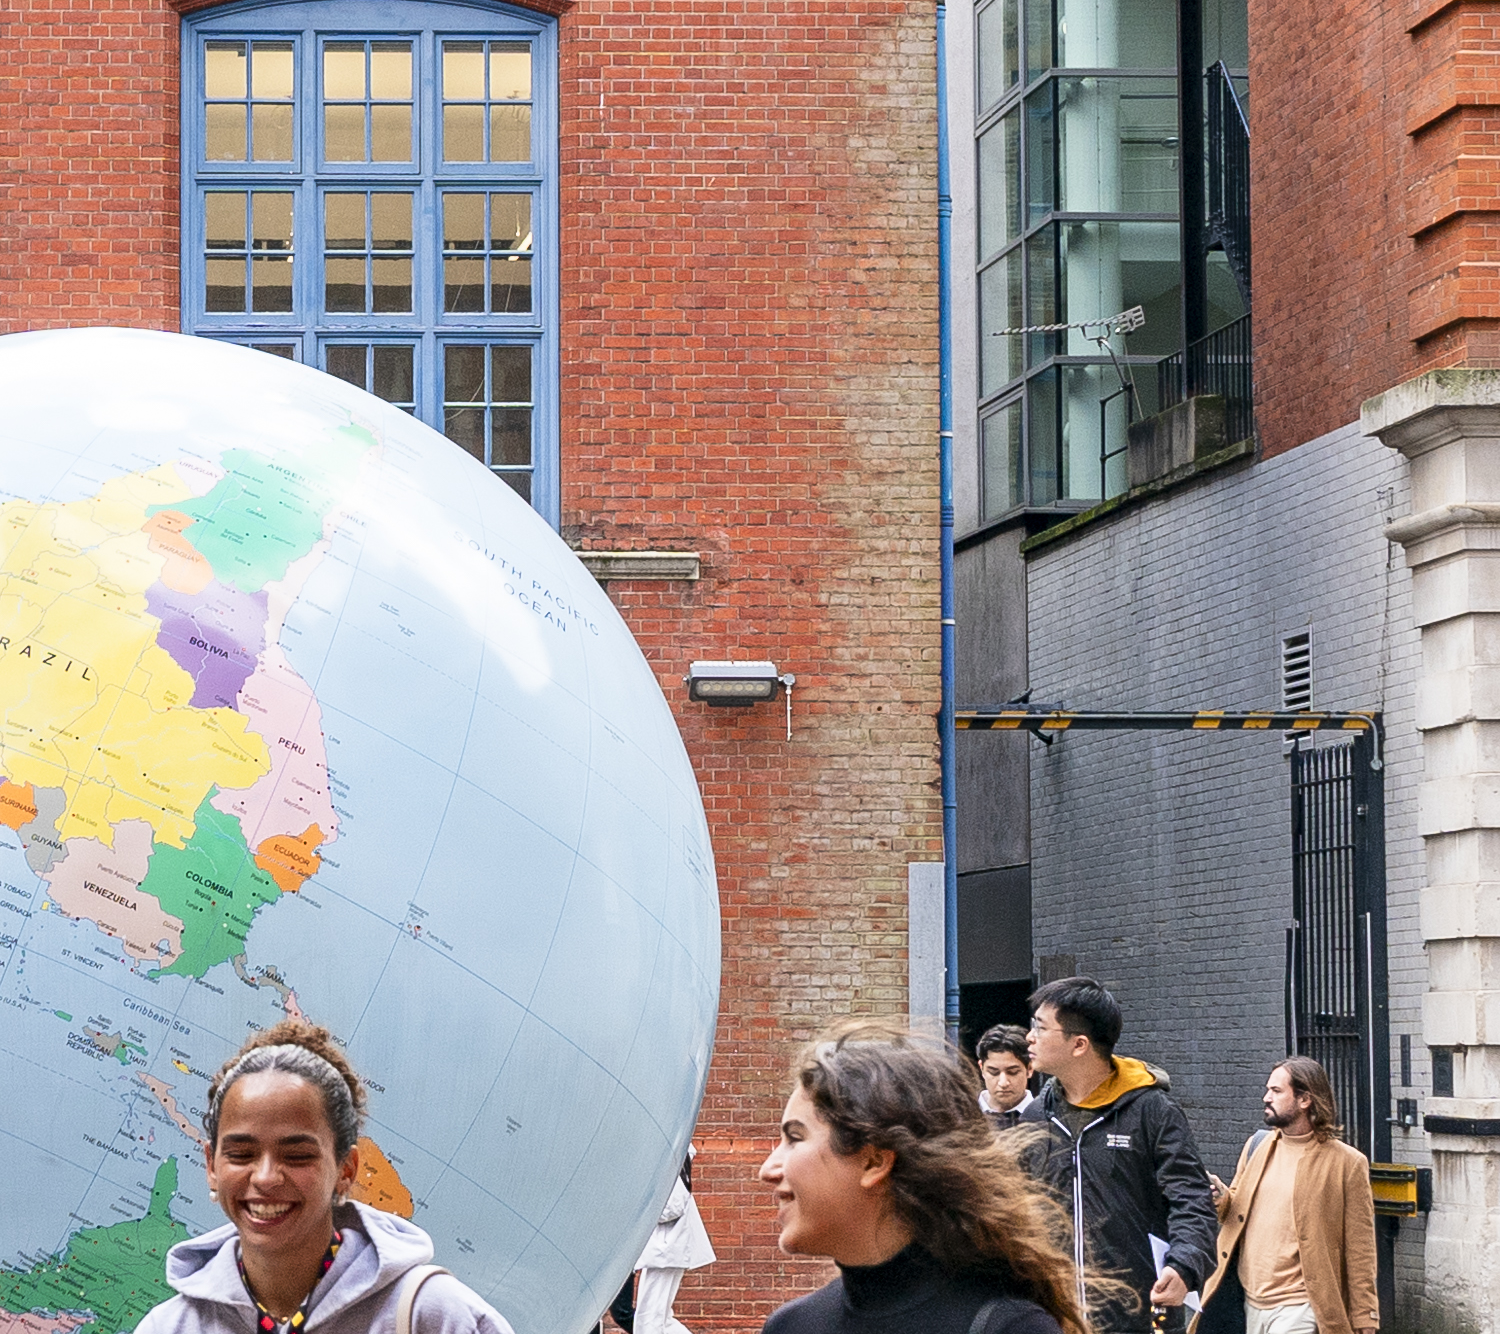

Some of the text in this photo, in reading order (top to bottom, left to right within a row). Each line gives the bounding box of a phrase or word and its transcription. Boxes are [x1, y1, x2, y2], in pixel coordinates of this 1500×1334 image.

[178, 460, 219, 479] URUGUAY
[339, 511, 368, 528] CHILE
[158, 543, 201, 564] PARAGUAY
[453, 530, 600, 636] SOUTH PACIFIC
[503, 582, 567, 633] OCEAN
[189, 636, 230, 660] BOLIVIA
[277, 737, 306, 756] PERU
[0, 795, 39, 817] SURINAME
[31, 833, 63, 851] GUYANA
[273, 844, 311, 867] ECUADOR
[3, 883, 32, 900] TOBAGO
[185, 870, 234, 899] COLOMBIA
[83, 880, 138, 911] VENEZUELA
[0, 900, 33, 919] GRENADA
[74, 953, 105, 971] VINCENT
[255, 965, 286, 986] PANAMA
[123, 997, 192, 1036] Caribbean Sea
[66, 1040, 104, 1062] REPUBLIC
[129, 1054, 148, 1068] HAITI
[190, 1066, 214, 1083] JAMAIC
[96, 1140, 129, 1160] BAHAMAS
